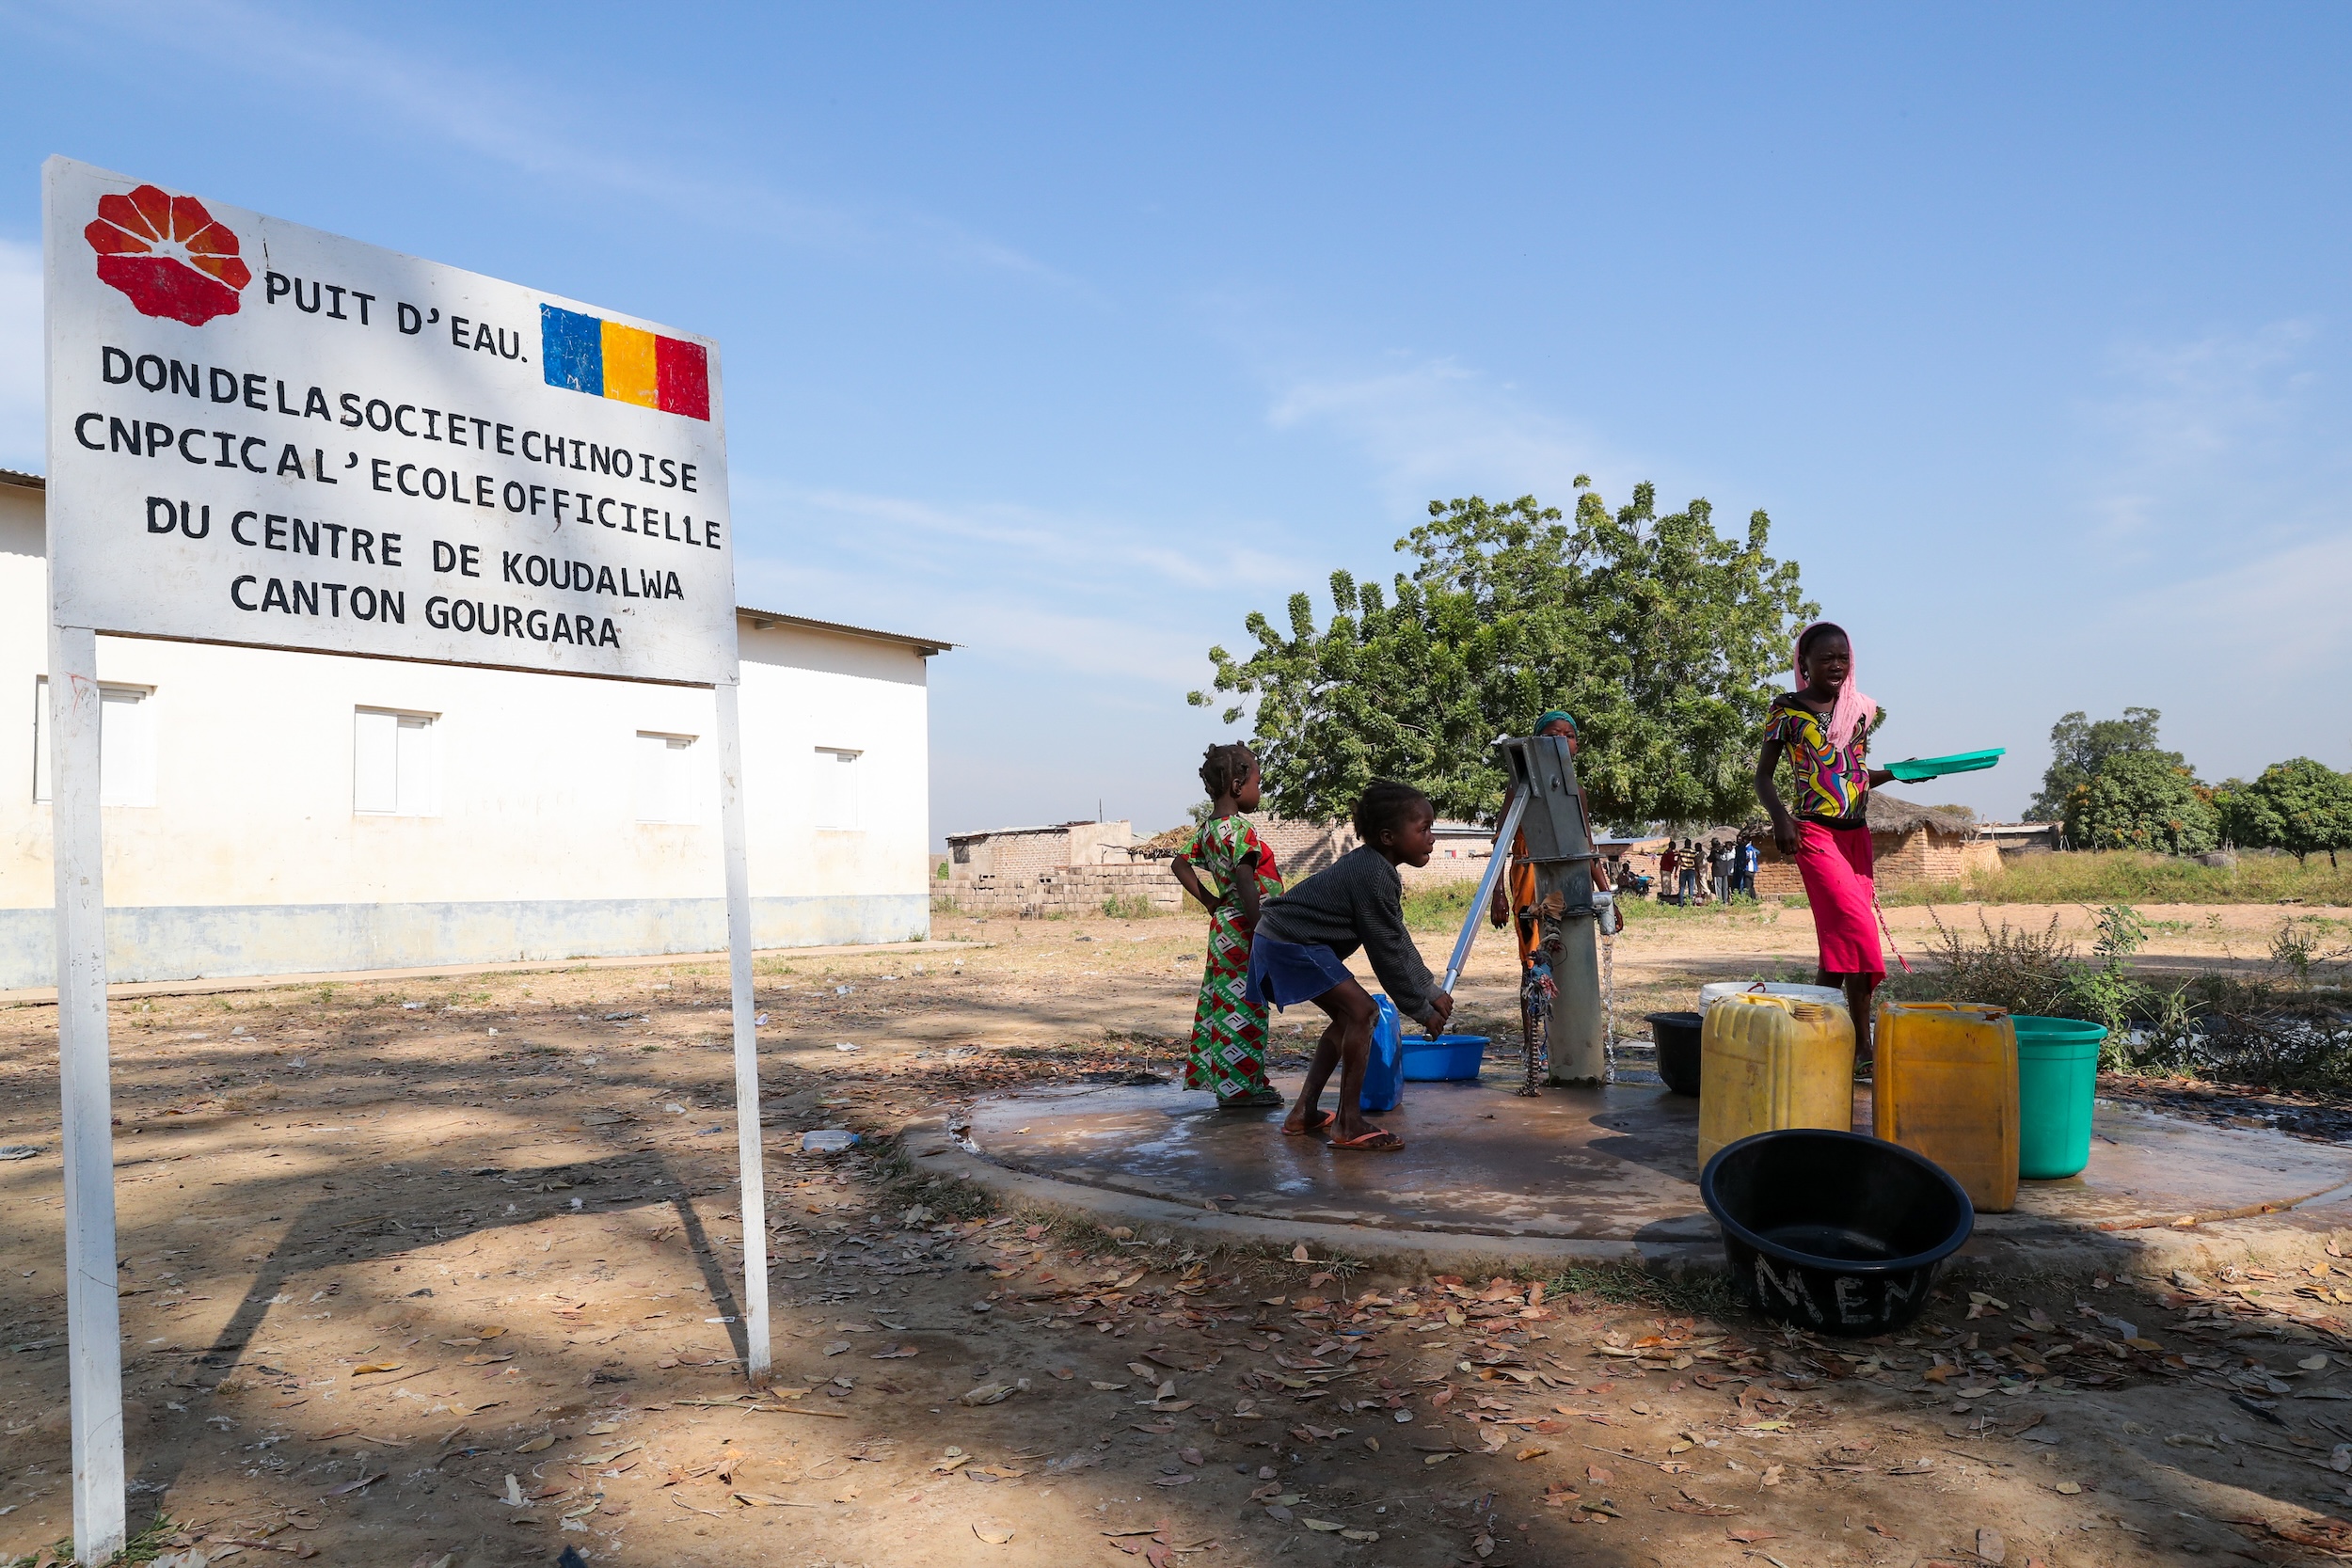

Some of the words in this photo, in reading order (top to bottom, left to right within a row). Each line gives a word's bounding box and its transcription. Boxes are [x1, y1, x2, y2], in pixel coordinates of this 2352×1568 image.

[263, 270, 376, 326] PUIT
[102, 345, 200, 399] DON
[340, 392, 515, 456] SOCIETE
[521, 430, 698, 494] CHINOISE
[146, 496, 210, 539] DU
[230, 511, 402, 567] CENTRE
[433, 540, 480, 578] DE
[502, 550, 685, 601] KOUDALWA
[502, 480, 722, 550] OFFICIELLE
[230, 575, 405, 625] CANTON
[424, 595, 621, 649] GOURGARA
[1237, 1040, 1263, 1063] ITALIA
